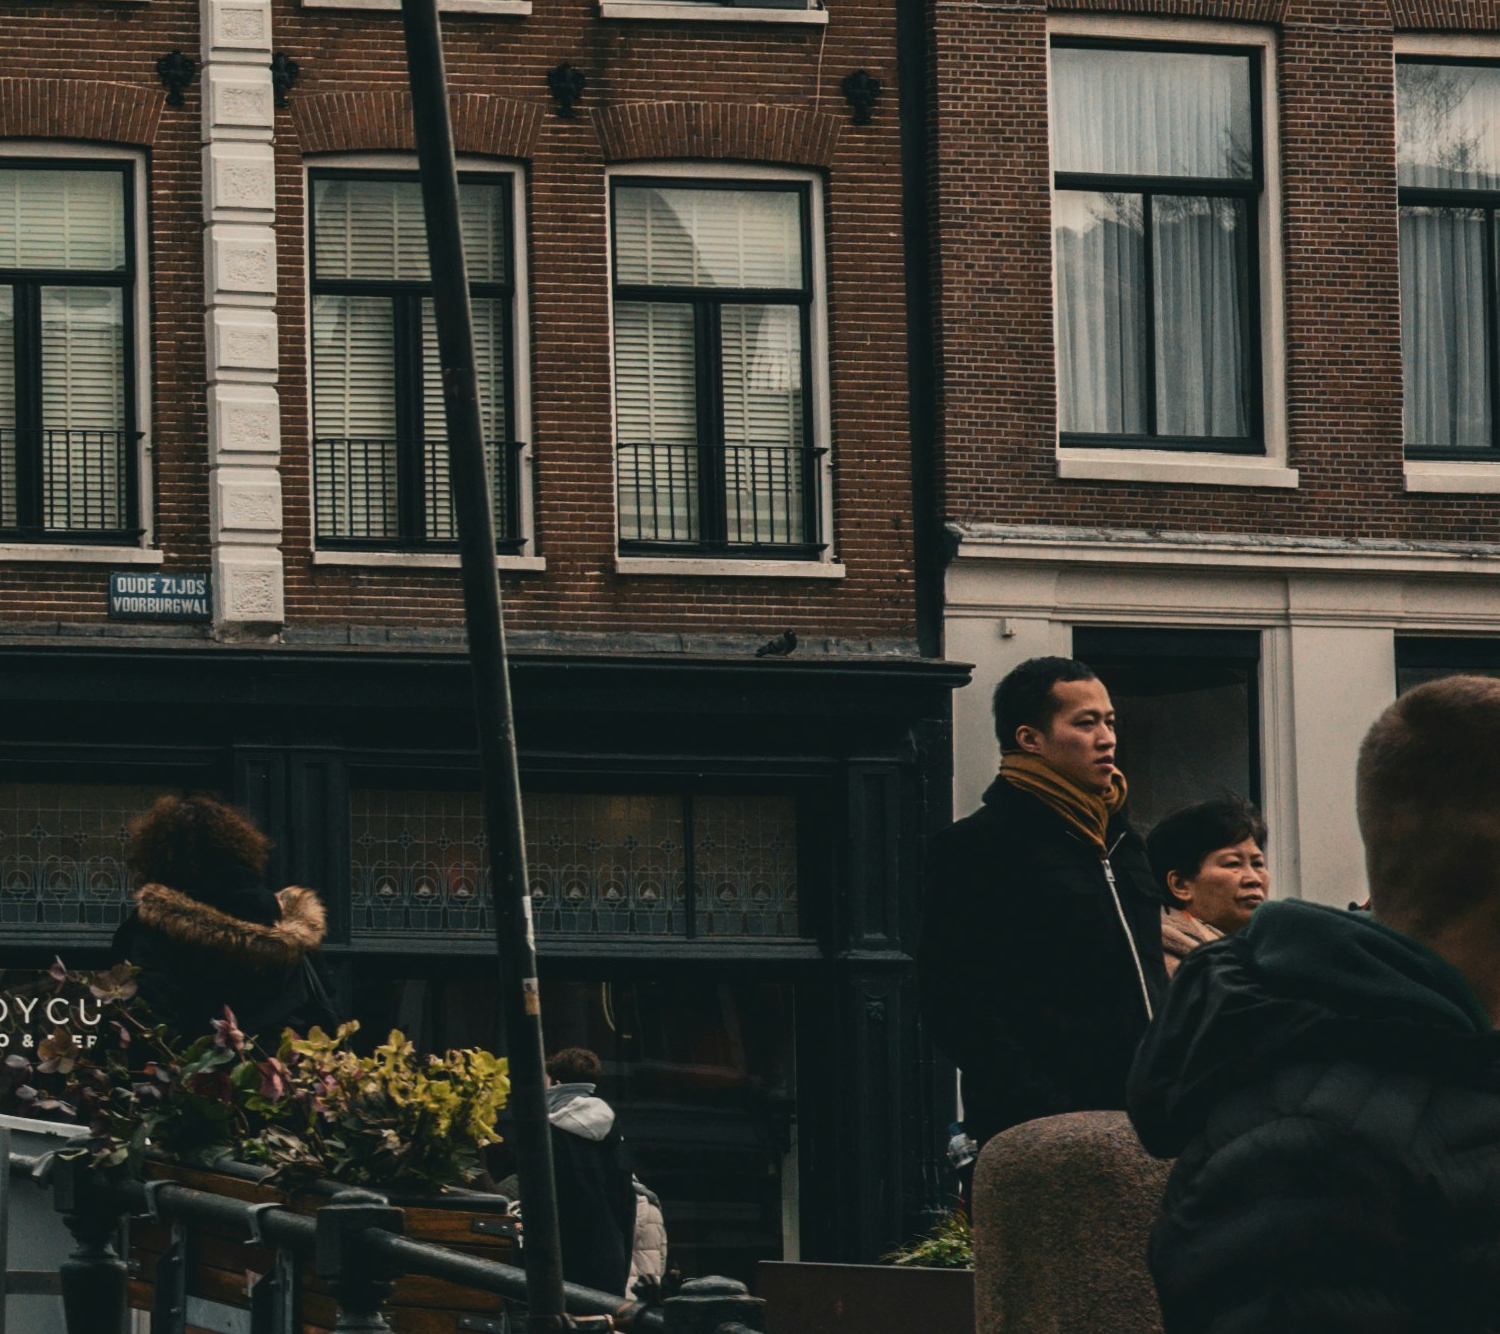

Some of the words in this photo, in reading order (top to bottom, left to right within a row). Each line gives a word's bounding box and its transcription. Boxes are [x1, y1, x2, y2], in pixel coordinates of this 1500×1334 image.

[117, 577, 156, 594] OUDE
[161, 578, 206, 595] ZIJDS
[113, 596, 210, 615] VOORBURGWAL
[21, 1034, 34, 1049] &
